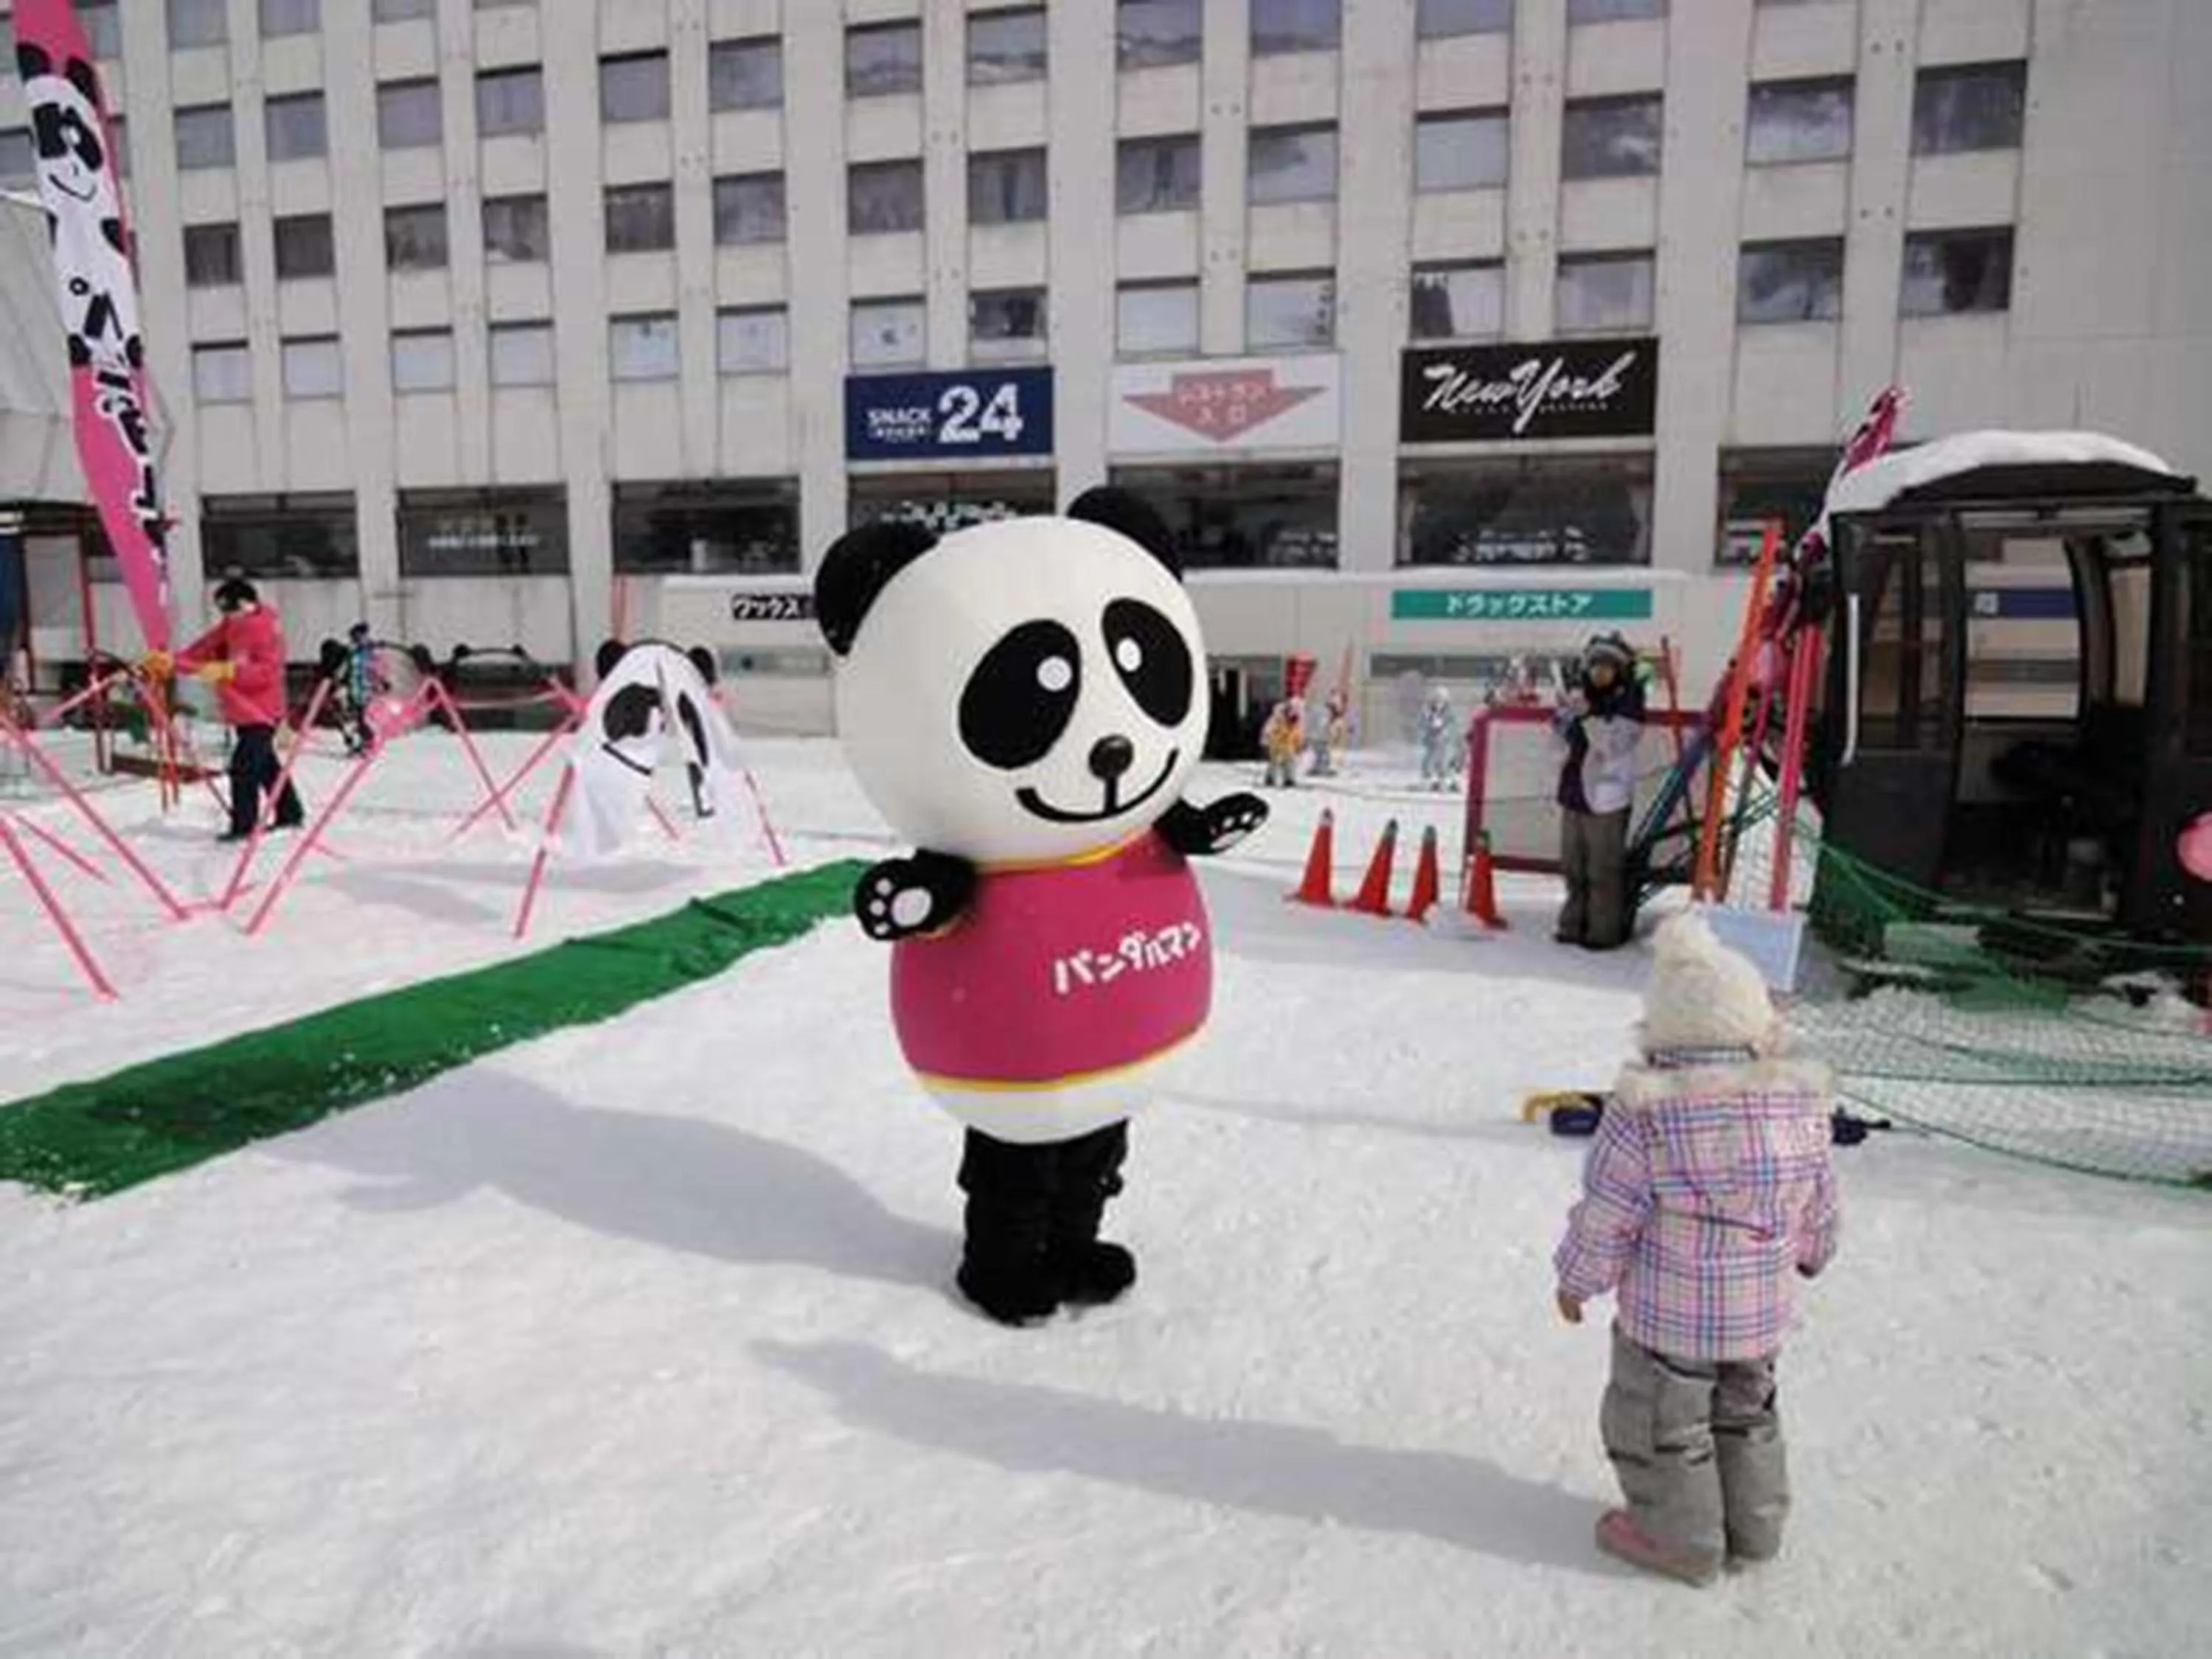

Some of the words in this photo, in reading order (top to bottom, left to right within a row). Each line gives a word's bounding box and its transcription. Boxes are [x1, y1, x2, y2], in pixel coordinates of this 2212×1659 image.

[937, 383, 1023, 443] 24
[1054, 922, 1202, 994] パンダルマン
